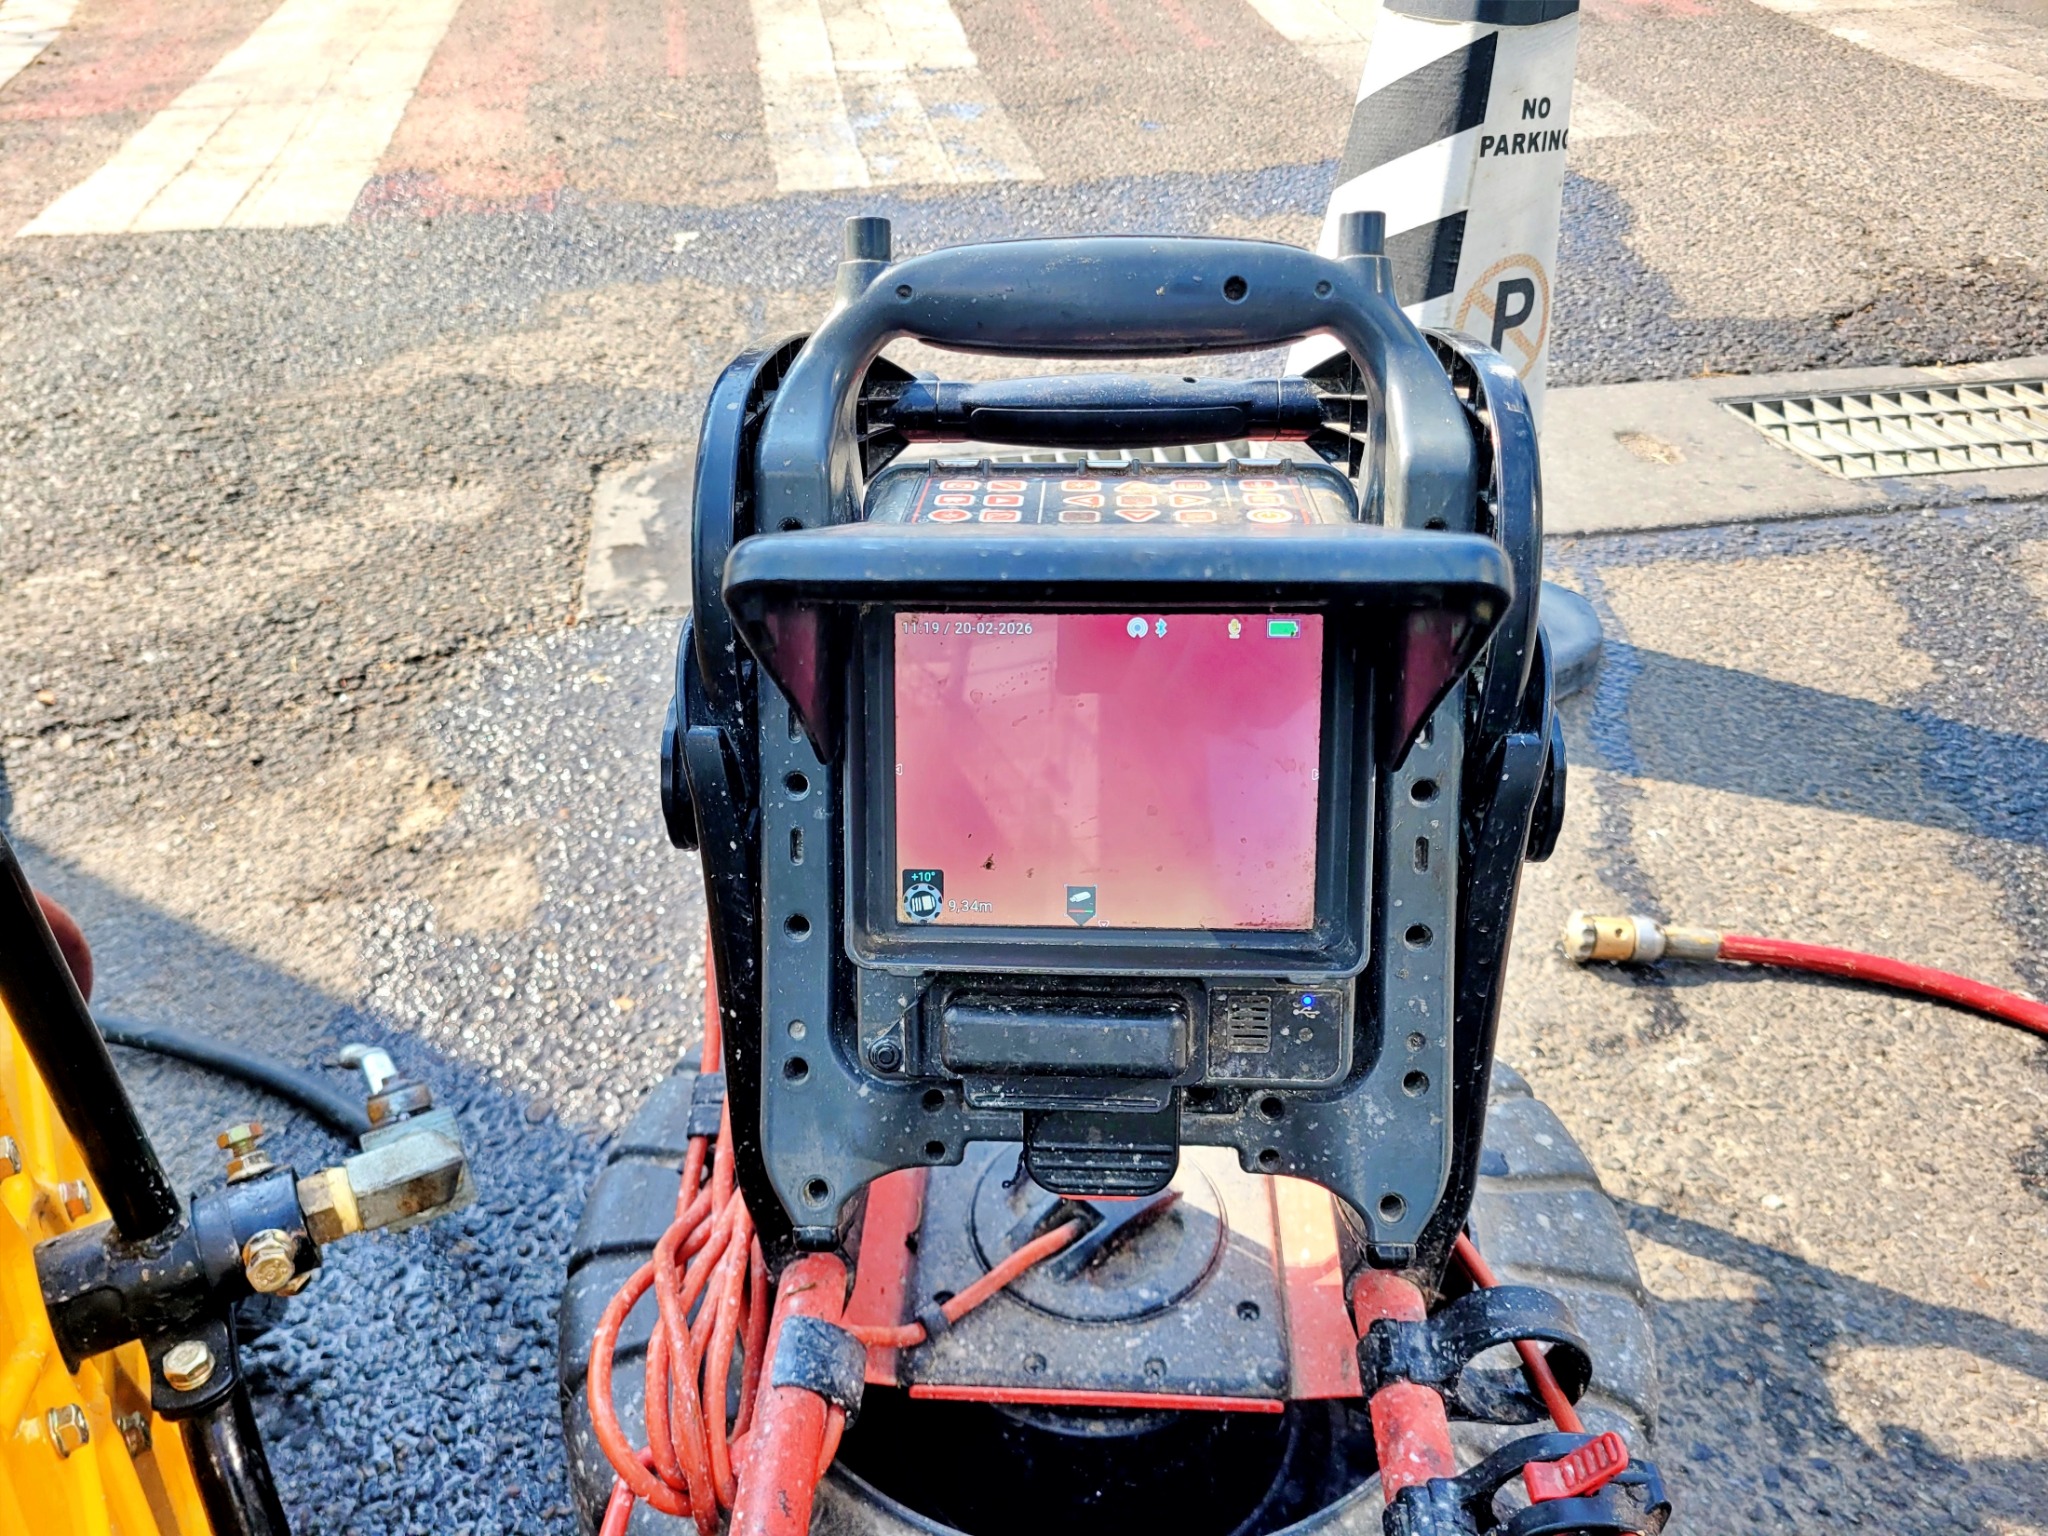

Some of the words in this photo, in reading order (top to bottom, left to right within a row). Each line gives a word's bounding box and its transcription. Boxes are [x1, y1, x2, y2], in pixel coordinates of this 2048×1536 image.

[1521, 97, 1551, 120] NO
[902, 622, 939, 634] 11:19
[954, 622, 1033, 635] 20-02-2026
[911, 871, 936, 882] +10°
[948, 899, 993, 913] 9,34m
